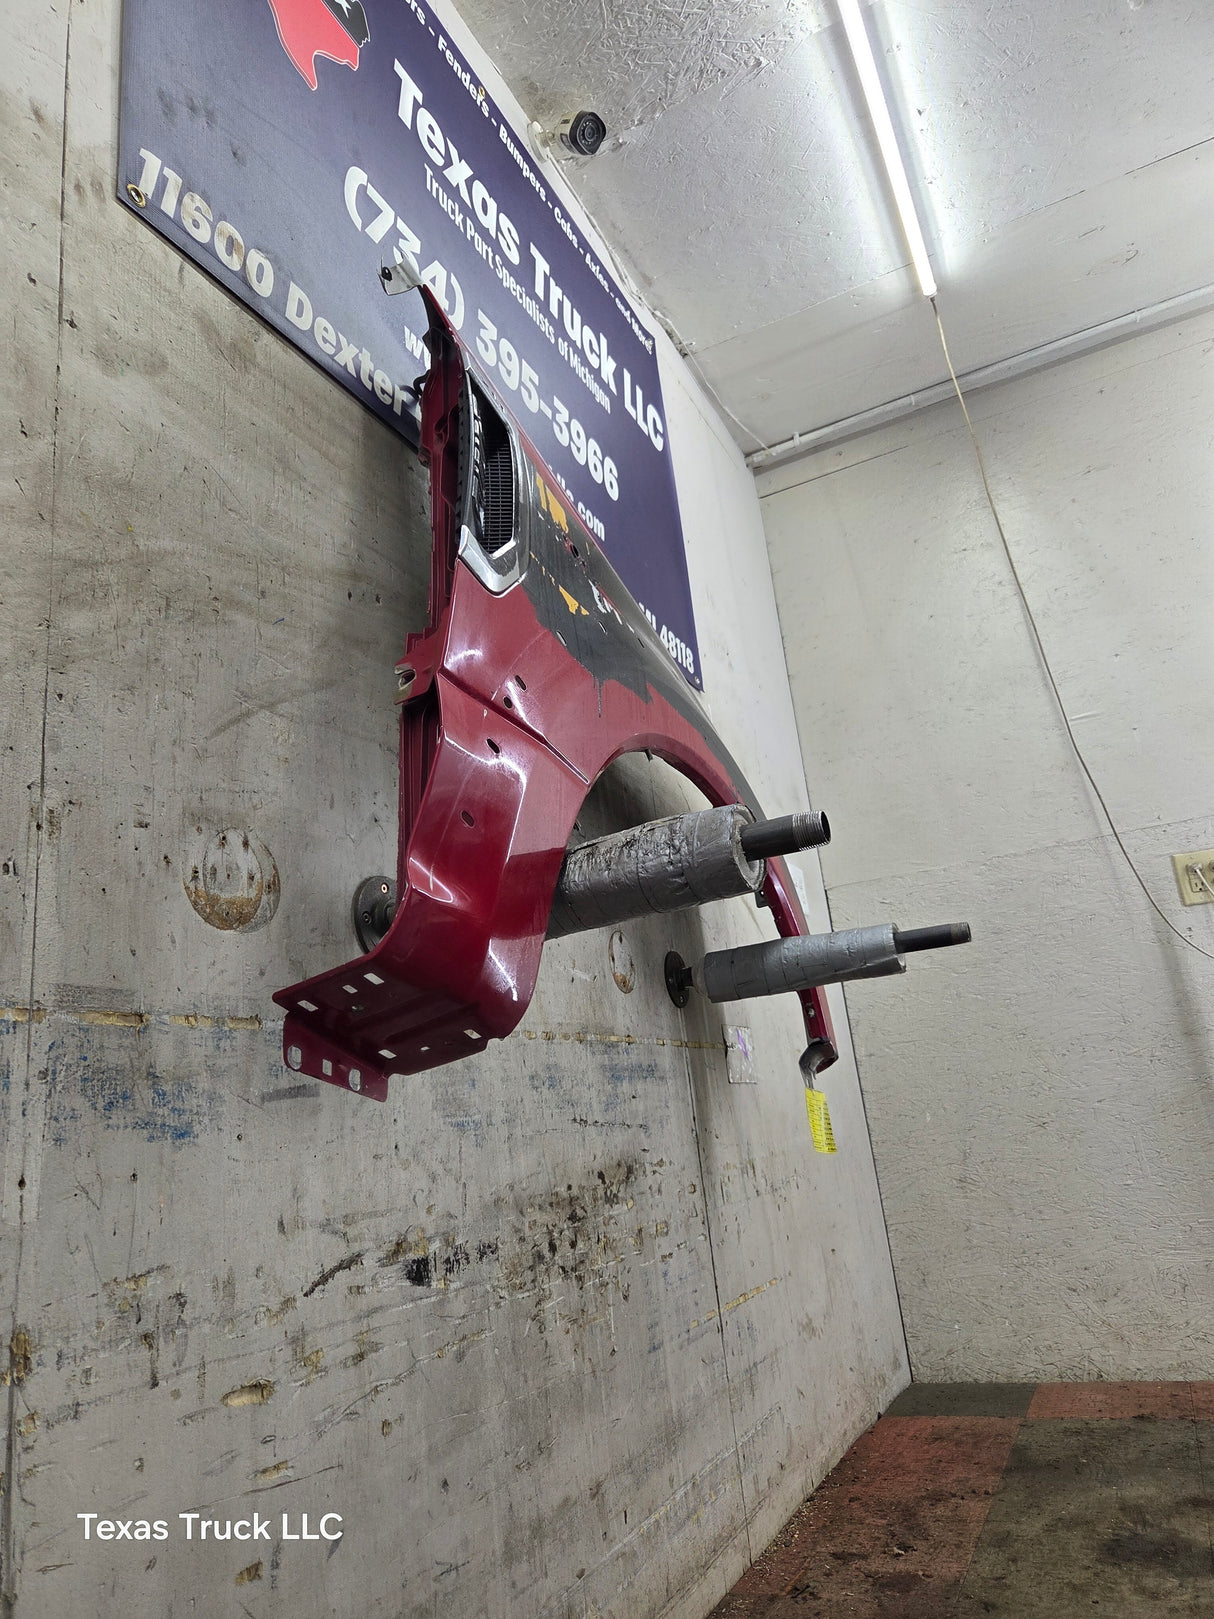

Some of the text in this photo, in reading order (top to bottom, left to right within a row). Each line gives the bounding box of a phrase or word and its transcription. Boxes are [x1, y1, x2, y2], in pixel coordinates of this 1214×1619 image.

[344, 166, 619, 502] (734) 395-3966
[394, 58, 664, 452] Texas Truck LLC
[424, 163, 611, 415] Truck Part Specialists of Michigan
[438, 34, 490, 118] Fenders
[499, 123, 546, 202] Bumpers
[554, 206, 579, 249] Cabs
[585, 252, 610, 293] Axles
[615, 297, 632, 325] and
[138, 147, 275, 298] 11600
[285, 281, 407, 417] Dexter
[660, 624, 695, 674] 48118
